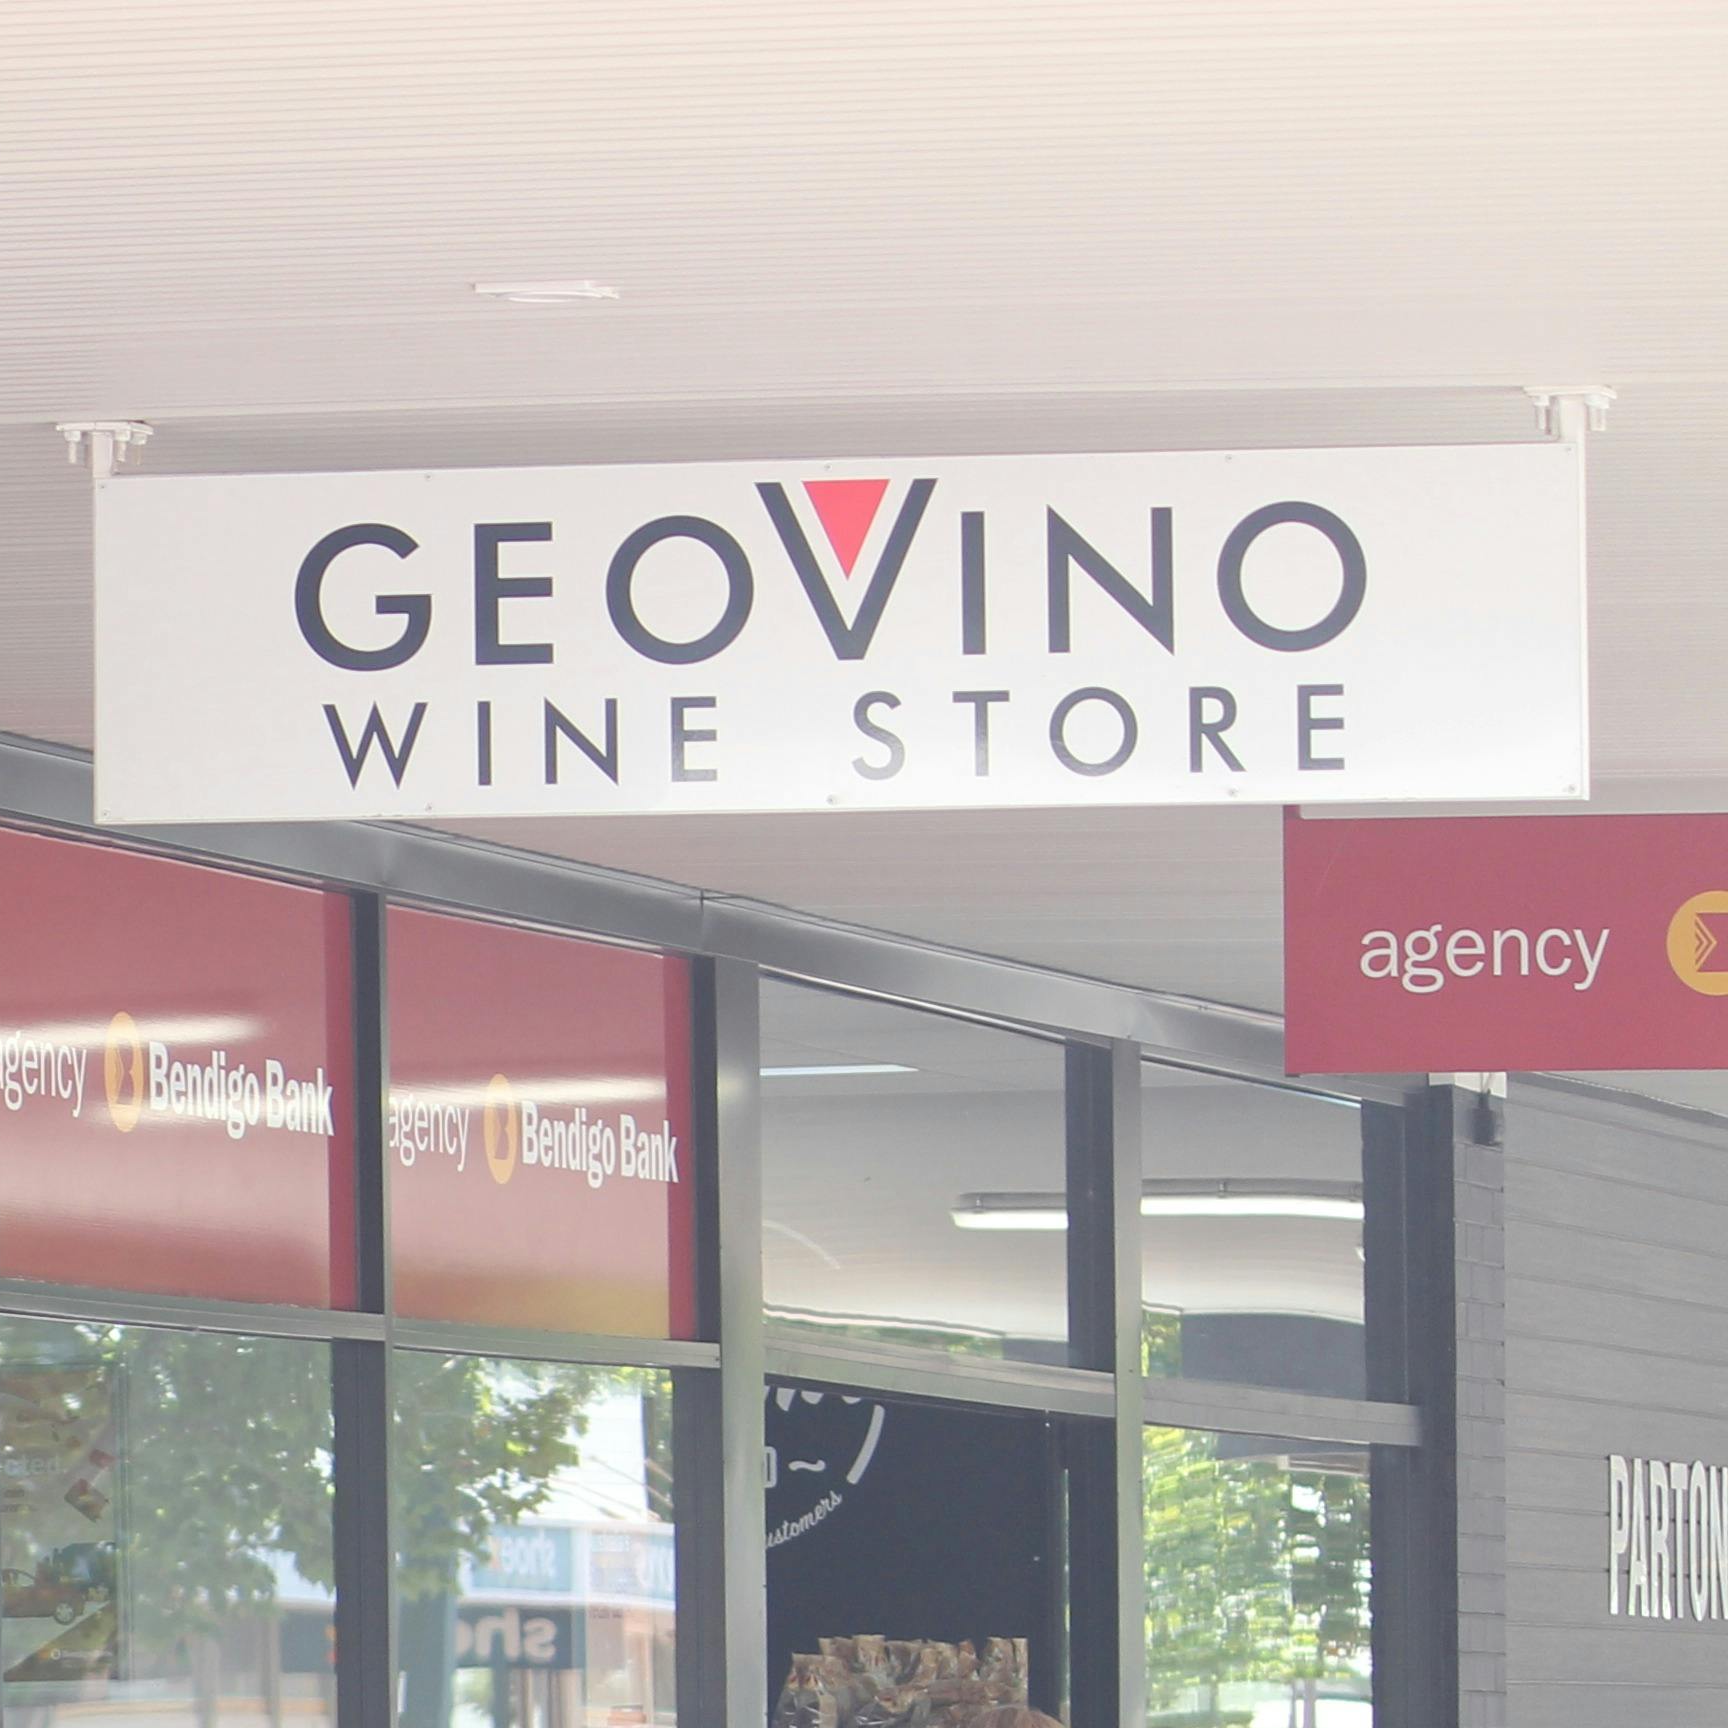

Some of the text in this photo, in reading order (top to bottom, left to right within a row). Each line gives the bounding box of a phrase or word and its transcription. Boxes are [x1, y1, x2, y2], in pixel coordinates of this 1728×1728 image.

[294, 477, 1367, 673] GEOVINO
[322, 682, 1347, 790] WINE STORE
[1359, 923, 1611, 993] agency
[148, 1040, 260, 1140] Bendigo
[265, 1059, 334, 1138] Bank
[520, 1100, 615, 1189] Bendigo
[619, 1112, 679, 1184] Bank
